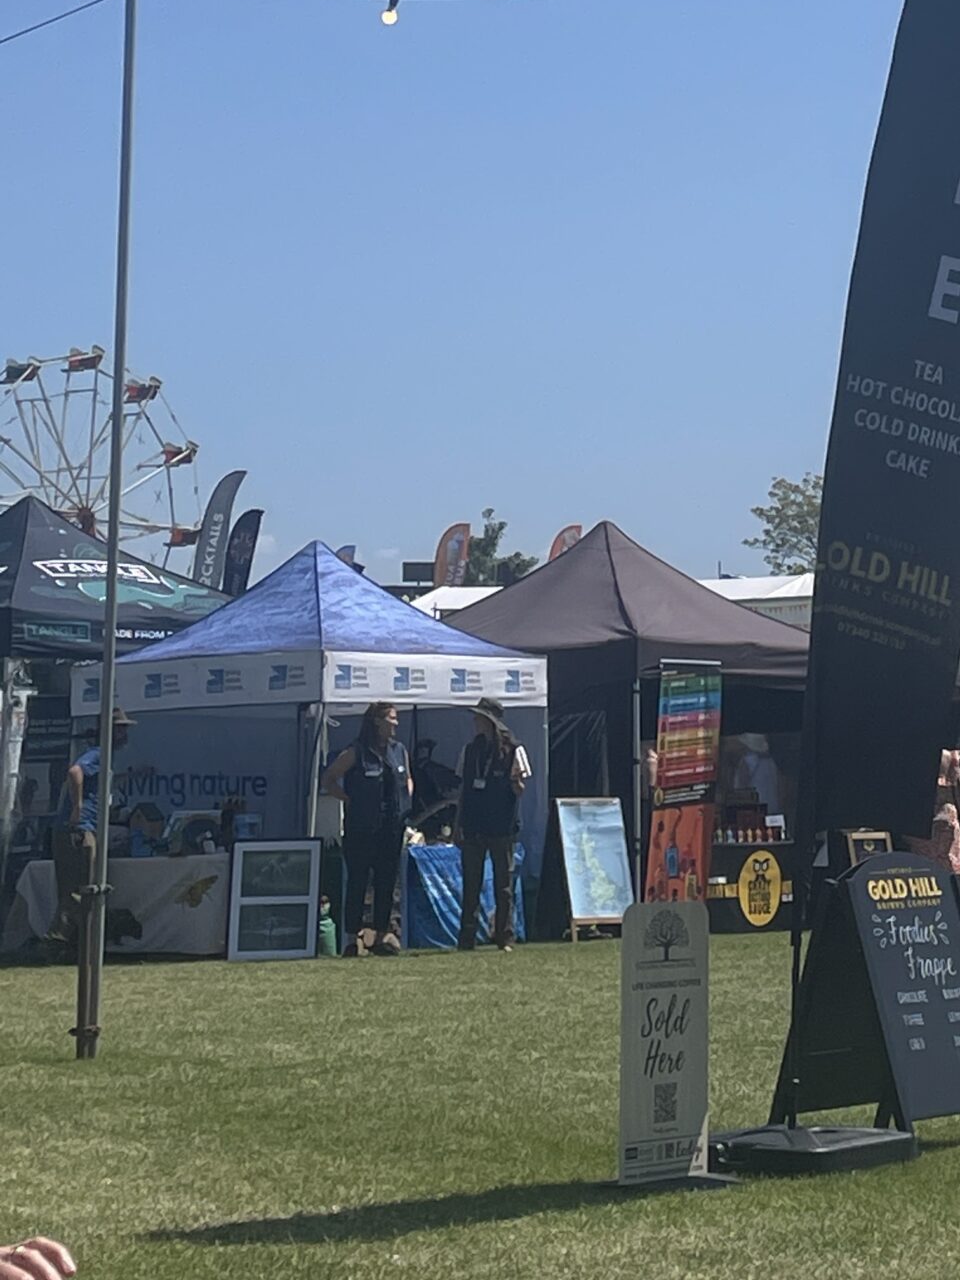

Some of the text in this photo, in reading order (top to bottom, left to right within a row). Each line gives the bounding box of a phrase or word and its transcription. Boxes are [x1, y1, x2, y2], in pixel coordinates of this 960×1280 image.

[914, 358, 945, 386] TEA
[846, 373, 887, 401] HOT
[854, 408, 904, 437] COLD
[885, 449, 931, 478] CAKE
[817, 540, 891, 584] OLD
[897, 560, 951, 606] HILL
[190, 770, 268, 798] nature
[867, 876, 943, 901] GOLD HILL
[640, 993, 691, 1039] Sold
[643, 1039, 685, 1079] Here
